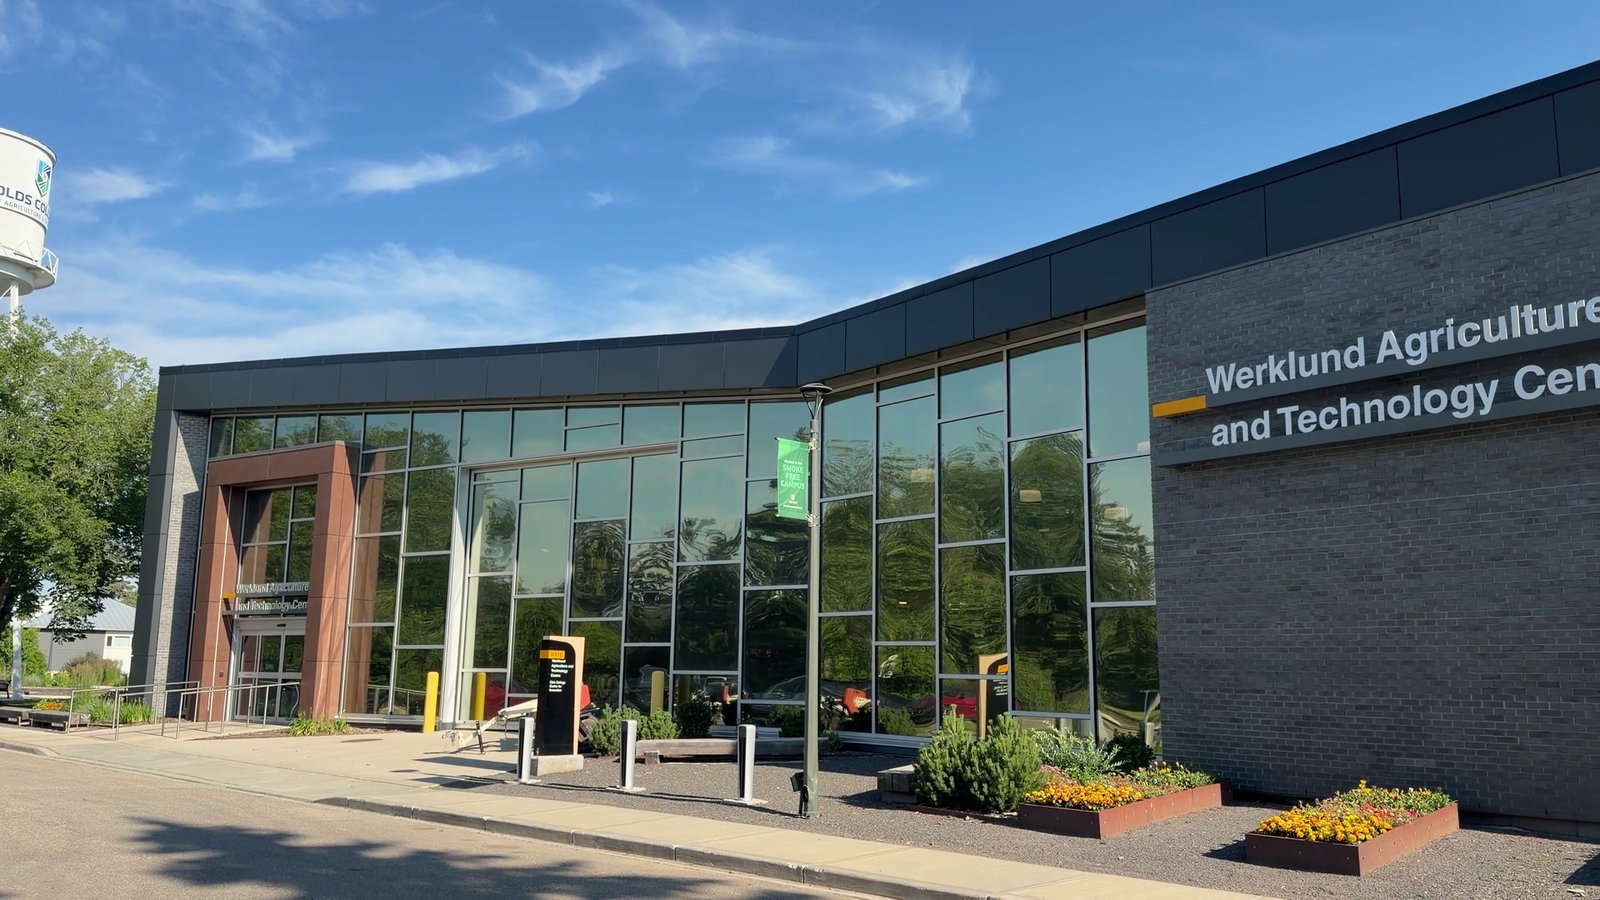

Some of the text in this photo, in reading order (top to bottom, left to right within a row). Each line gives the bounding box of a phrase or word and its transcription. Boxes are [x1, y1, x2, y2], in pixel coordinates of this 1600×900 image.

[0, 185, 32, 205] OLDS
[1206, 296, 1600, 395] Werklund Agriculture
[1211, 362, 1600, 447] and Technology Cen
[782, 464, 804, 474] SMOKE
[785, 472, 801, 481] FREE
[780, 480, 805, 490] CAMPUS
[269, 582, 309, 594] Agriculture
[251, 600, 291, 612] Technology
